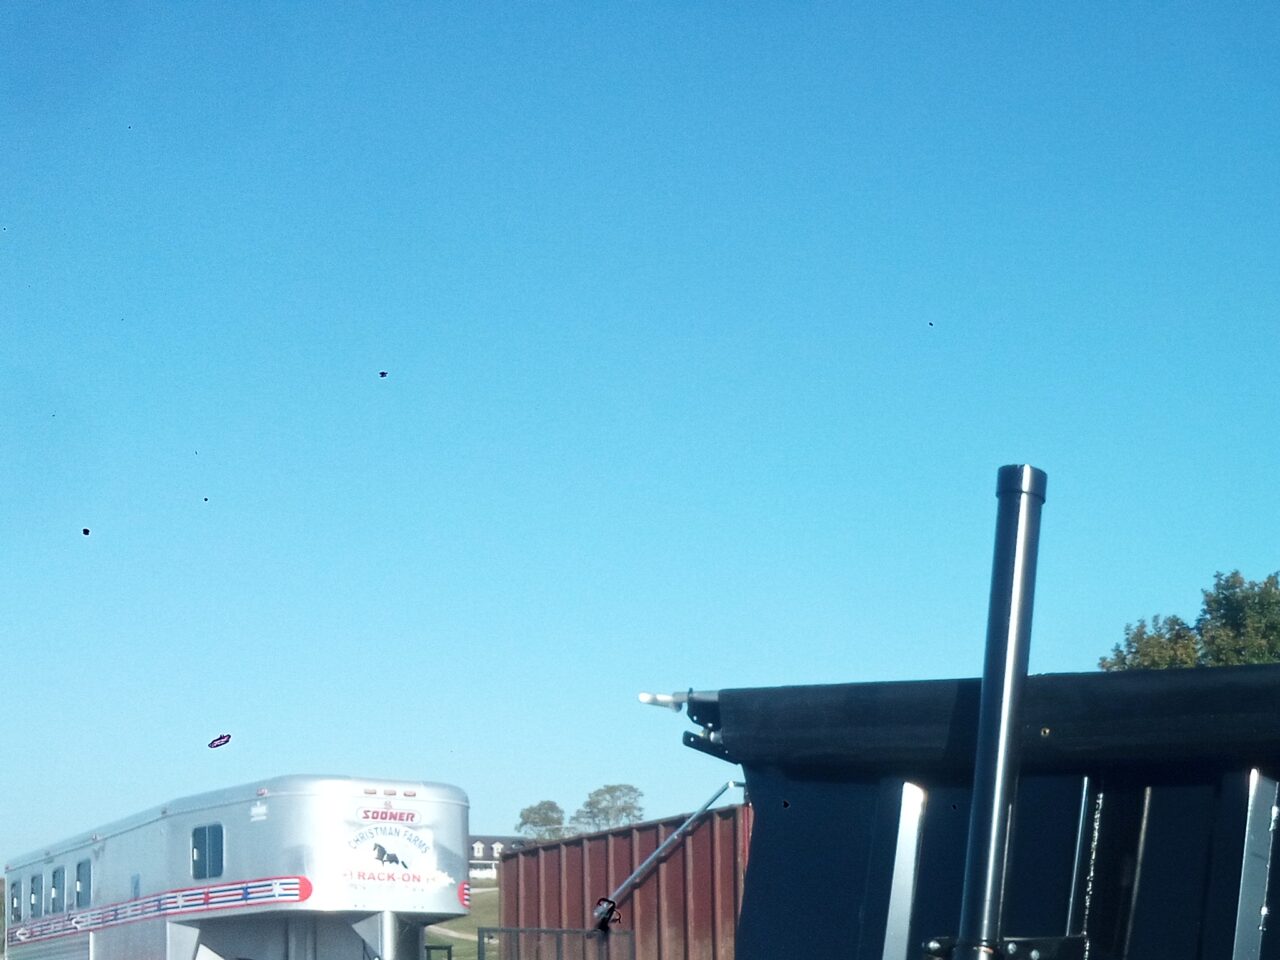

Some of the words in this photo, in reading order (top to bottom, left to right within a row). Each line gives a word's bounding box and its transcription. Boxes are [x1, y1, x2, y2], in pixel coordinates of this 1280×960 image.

[362, 810, 415, 822] SOONER
[348, 826, 400, 849] CHRISTMAN
[403, 830, 430, 854] FARMS
